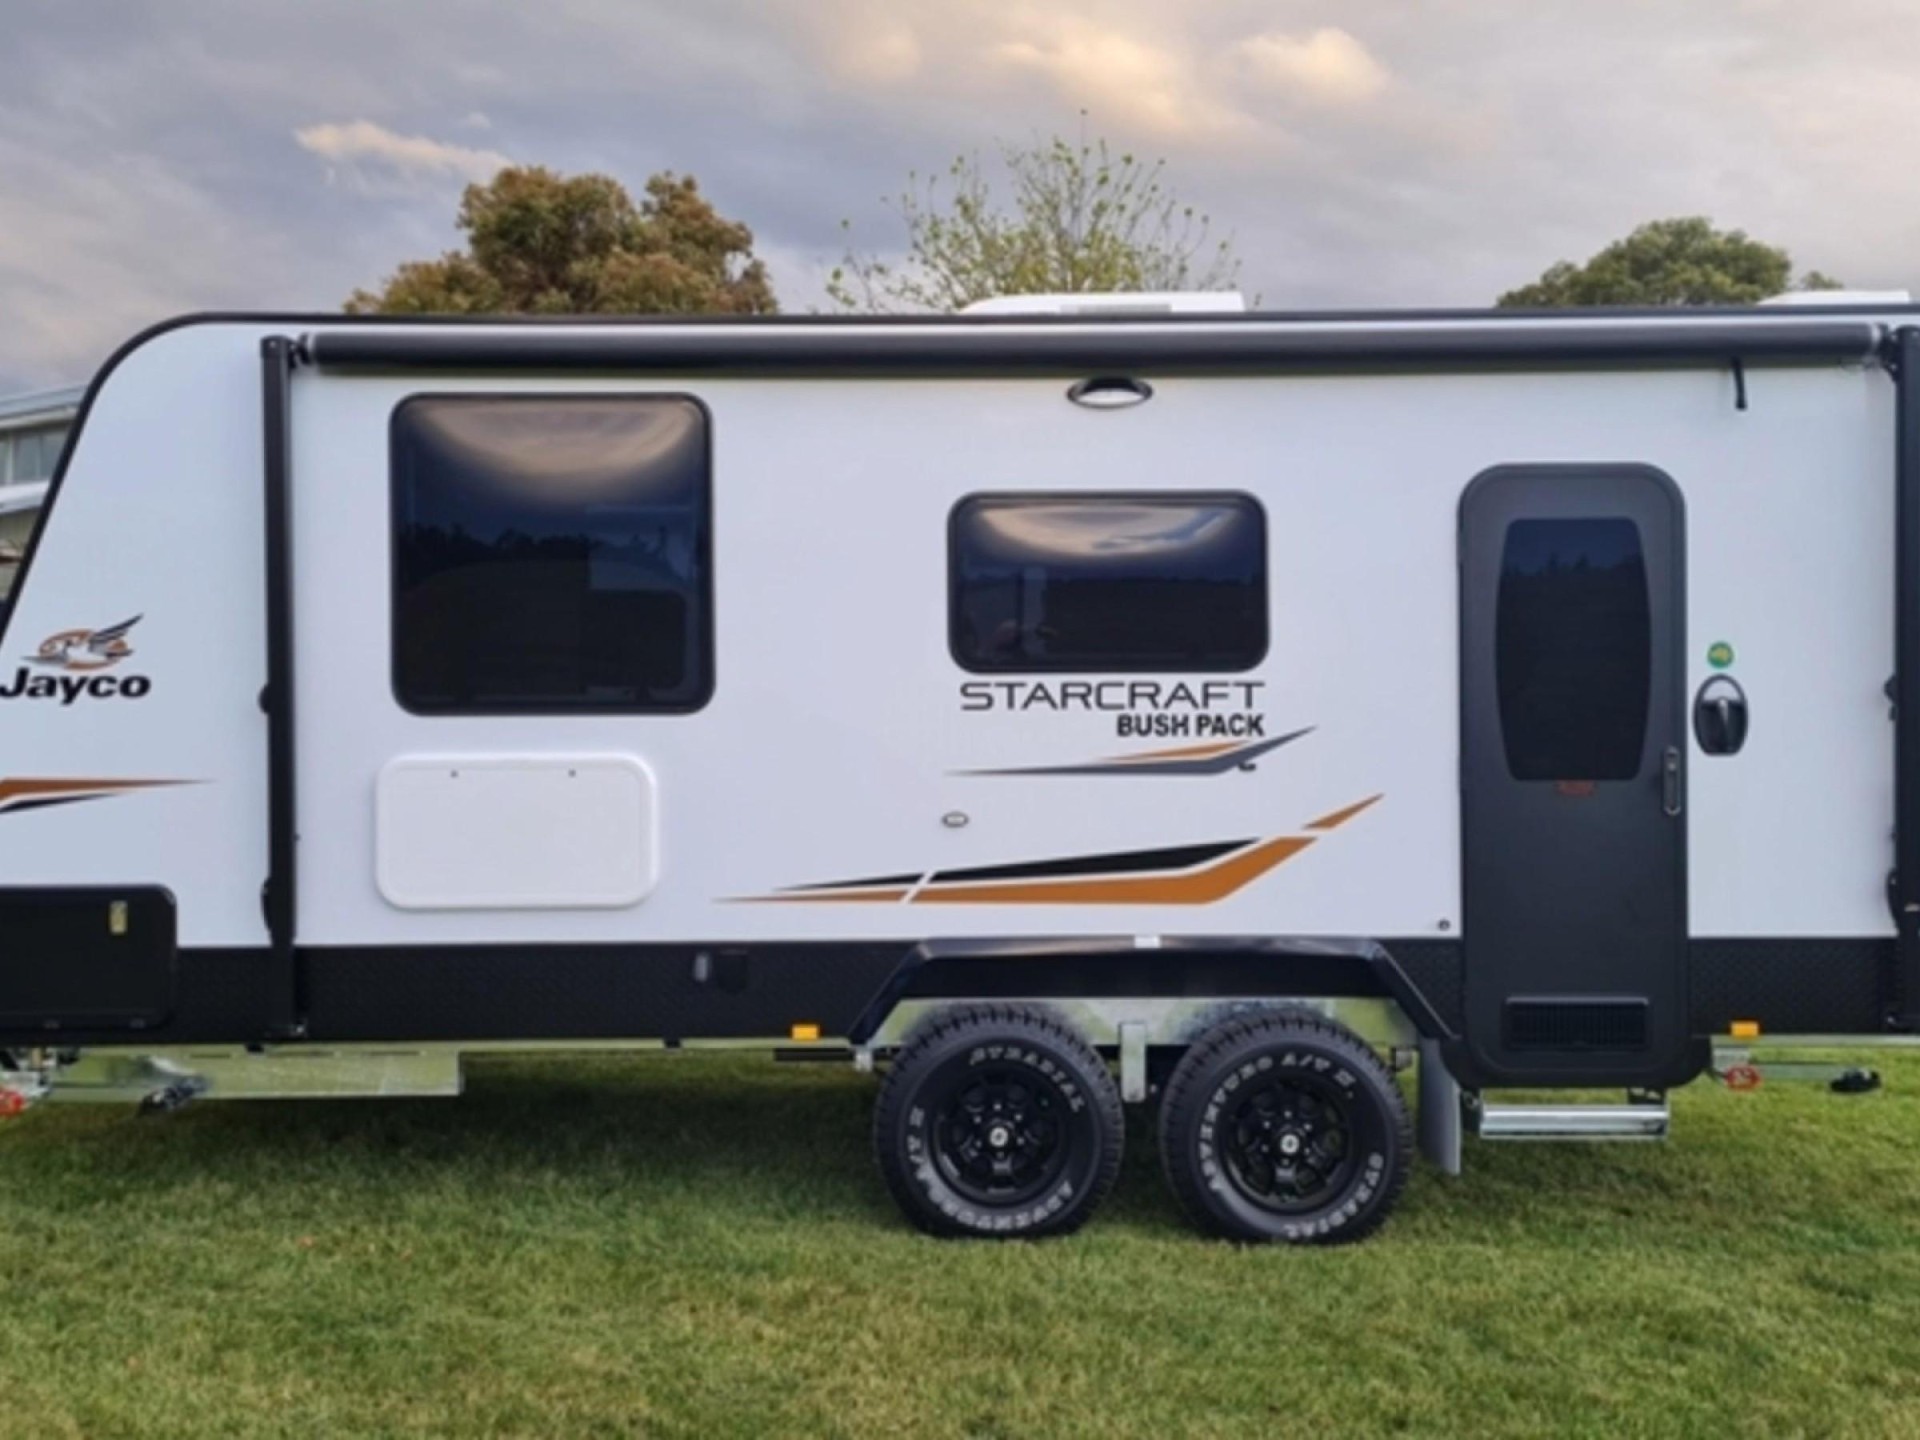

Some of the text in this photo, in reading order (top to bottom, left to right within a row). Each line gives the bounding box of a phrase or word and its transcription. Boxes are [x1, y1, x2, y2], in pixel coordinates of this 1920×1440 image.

[0, 666, 151, 705] Jayco
[960, 681, 1265, 710] STARCRAFT
[1117, 714, 1265, 737] BUSH PACK
